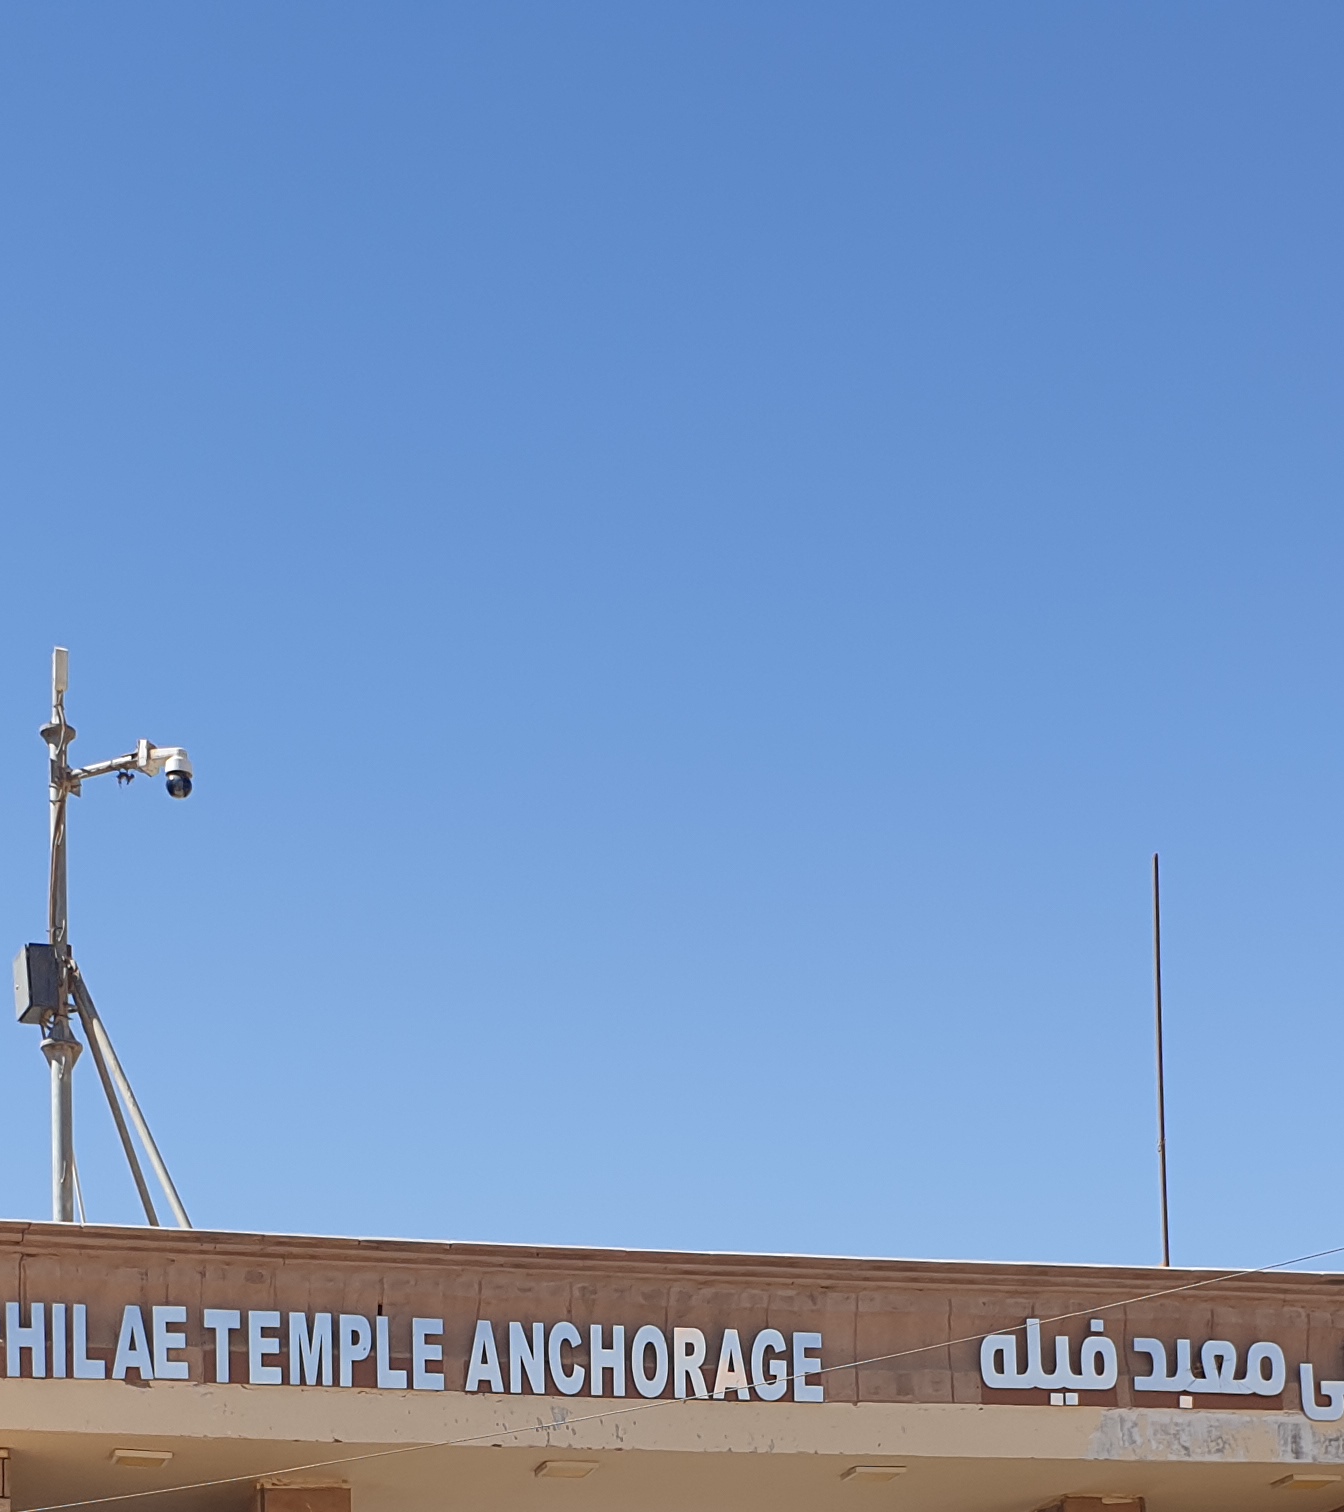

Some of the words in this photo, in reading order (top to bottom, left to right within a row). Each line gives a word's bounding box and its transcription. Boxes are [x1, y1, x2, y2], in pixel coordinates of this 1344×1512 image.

[204, 1309, 445, 1391] TEMPLE
[465, 1320, 824, 1403] ANCHORAGE
[1133, 1337, 1287, 1409] معبد
